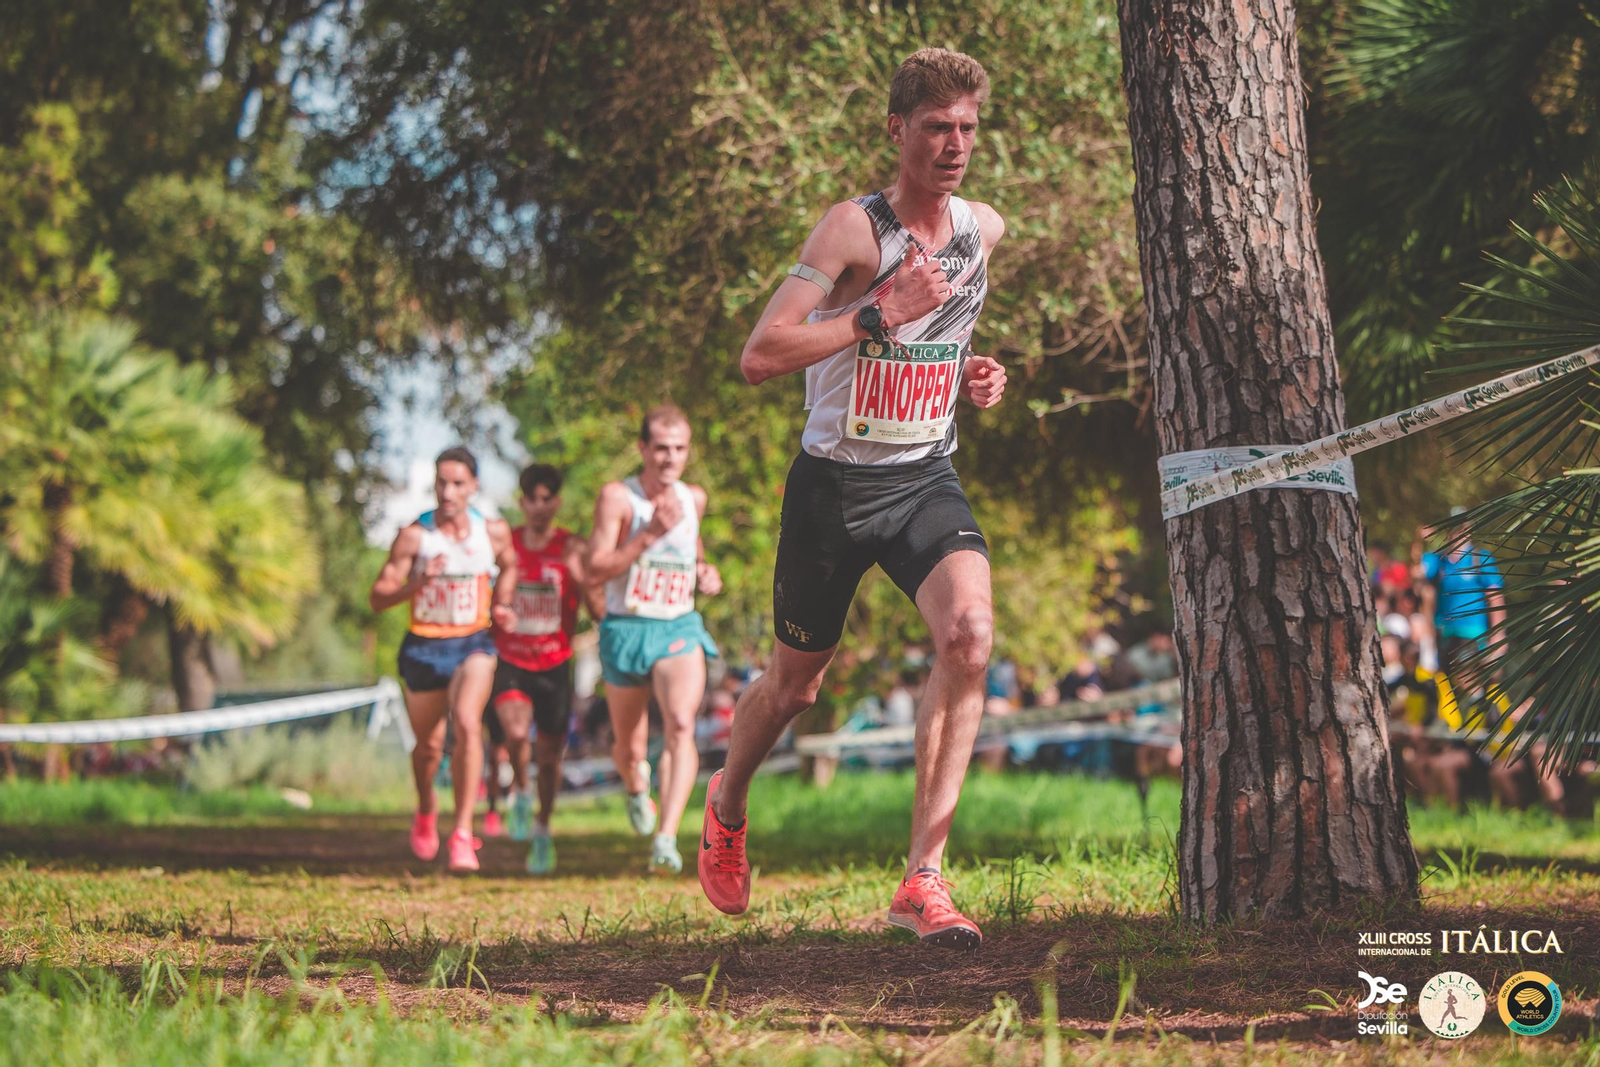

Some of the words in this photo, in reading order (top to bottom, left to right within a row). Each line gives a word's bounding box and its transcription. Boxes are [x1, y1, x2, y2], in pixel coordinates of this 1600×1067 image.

[890, 345, 940, 359] TÁLICA
[854, 358, 957, 422] VANOPPEN
[785, 620, 812, 643] WF
